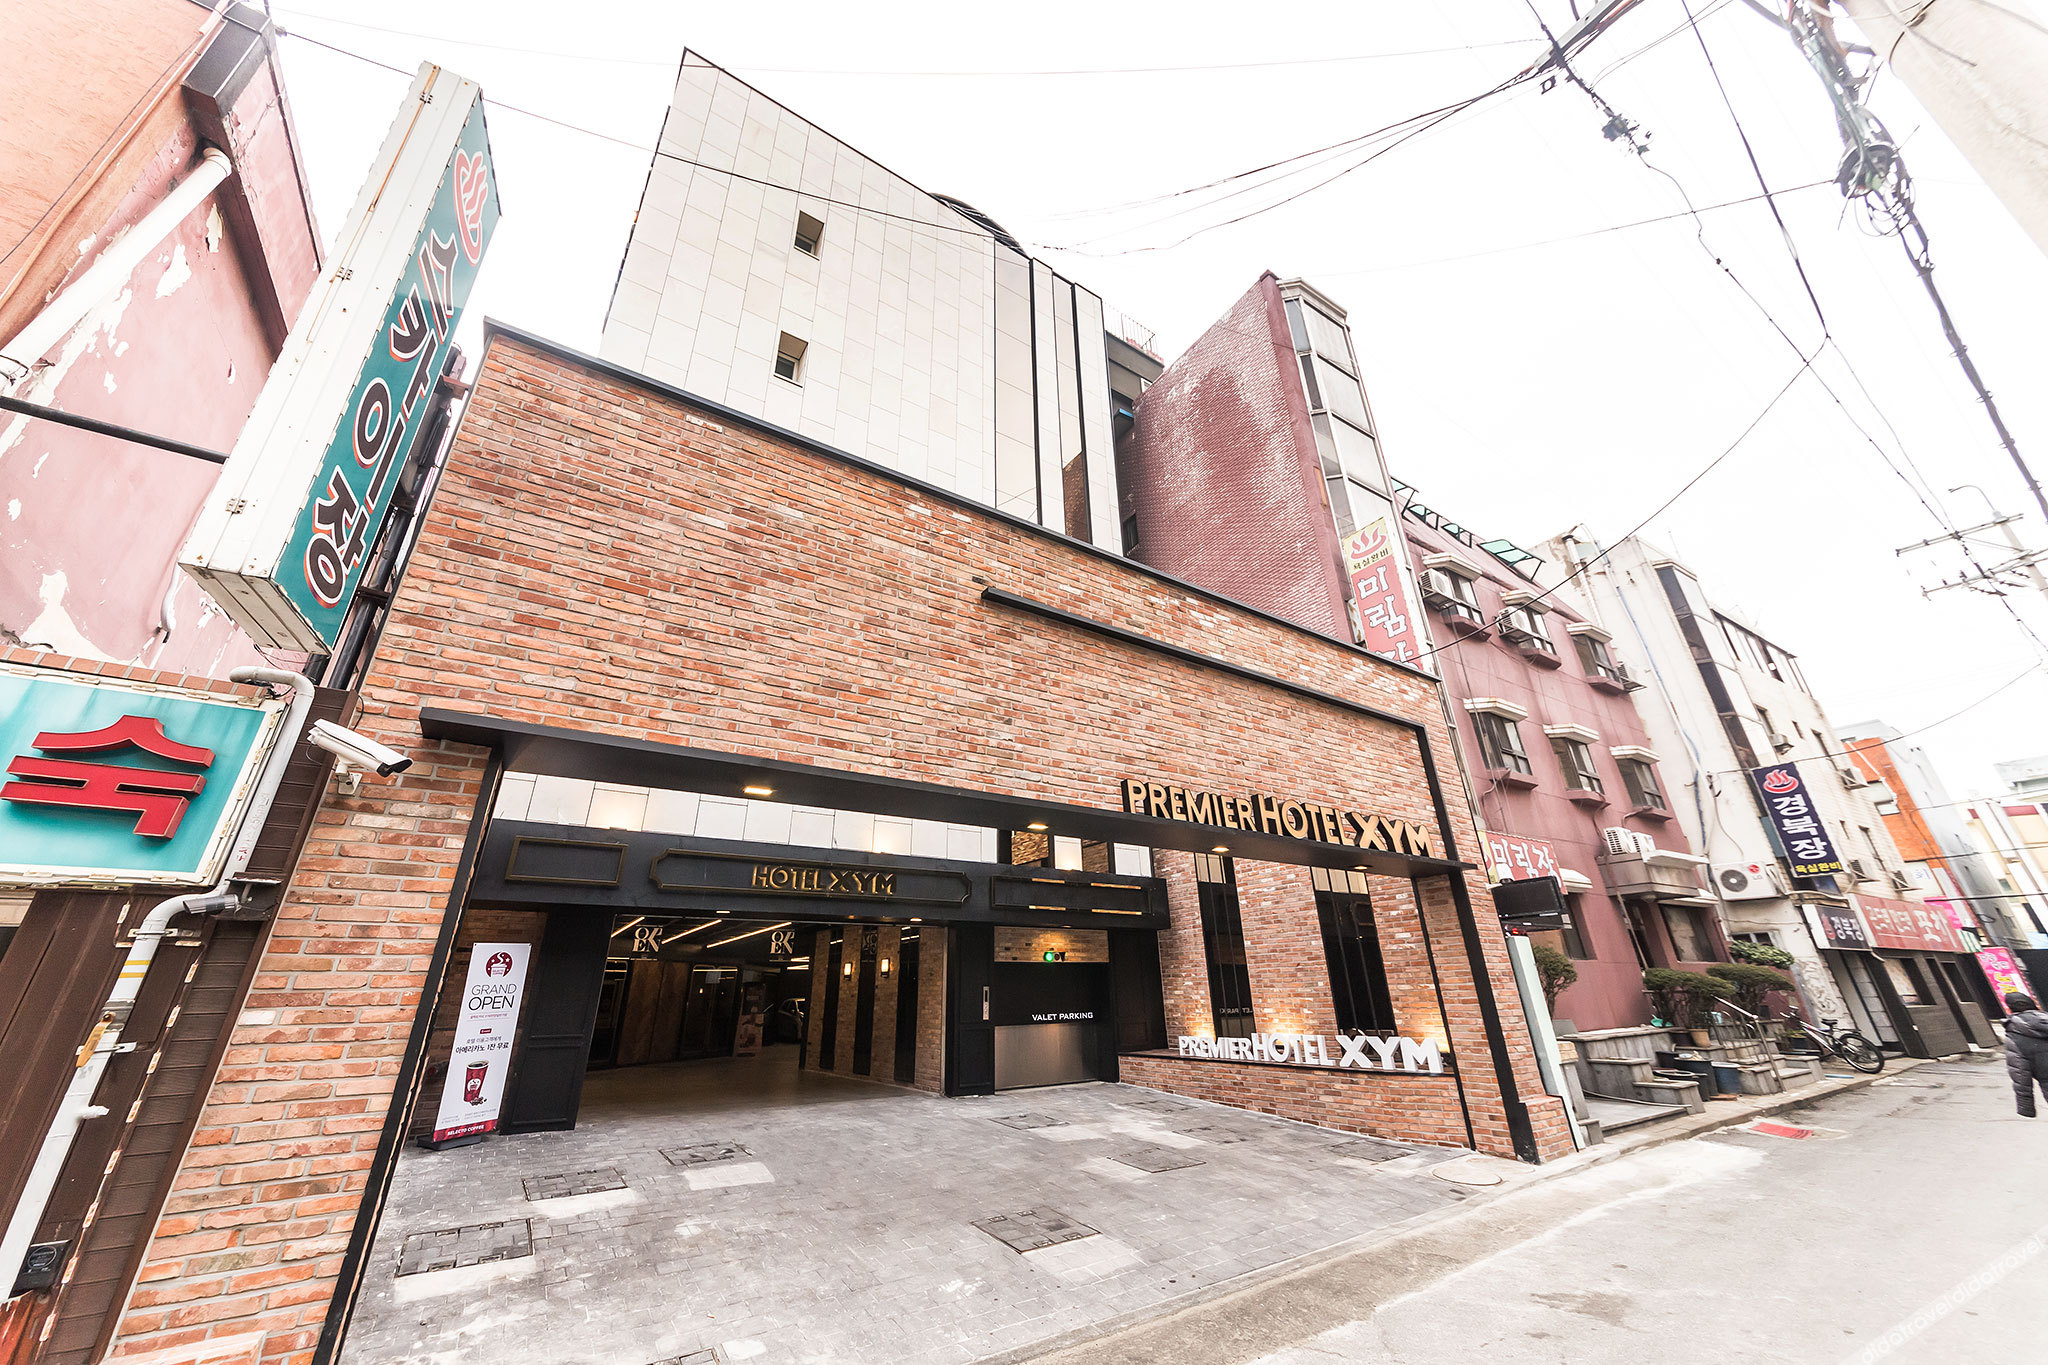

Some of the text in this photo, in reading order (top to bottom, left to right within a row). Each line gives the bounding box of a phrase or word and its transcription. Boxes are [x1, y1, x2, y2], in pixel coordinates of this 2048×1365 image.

[304, 230, 459, 608] 스카이장
[1, 714, 216, 840] 숙
[1121, 779, 1436, 859] PREMIER HOTEL XYM
[1772, 793, 1828, 860] 경북장
[751, 865, 898, 896] HOTEL XYM
[1795, 861, 1842, 873] 욕실완비
[1830, 915, 1865, 942] 경북장
[471, 983, 517, 995] GRAND
[468, 995, 515, 1011] OPEN
[1032, 1012, 1093, 1021] VALET PARKING
[455, 1044, 485, 1054] 아메리카노
[1178, 1032, 1444, 1073] PREMIER HOTEL XYM
[467, 1124, 485, 1132] COFFEE
